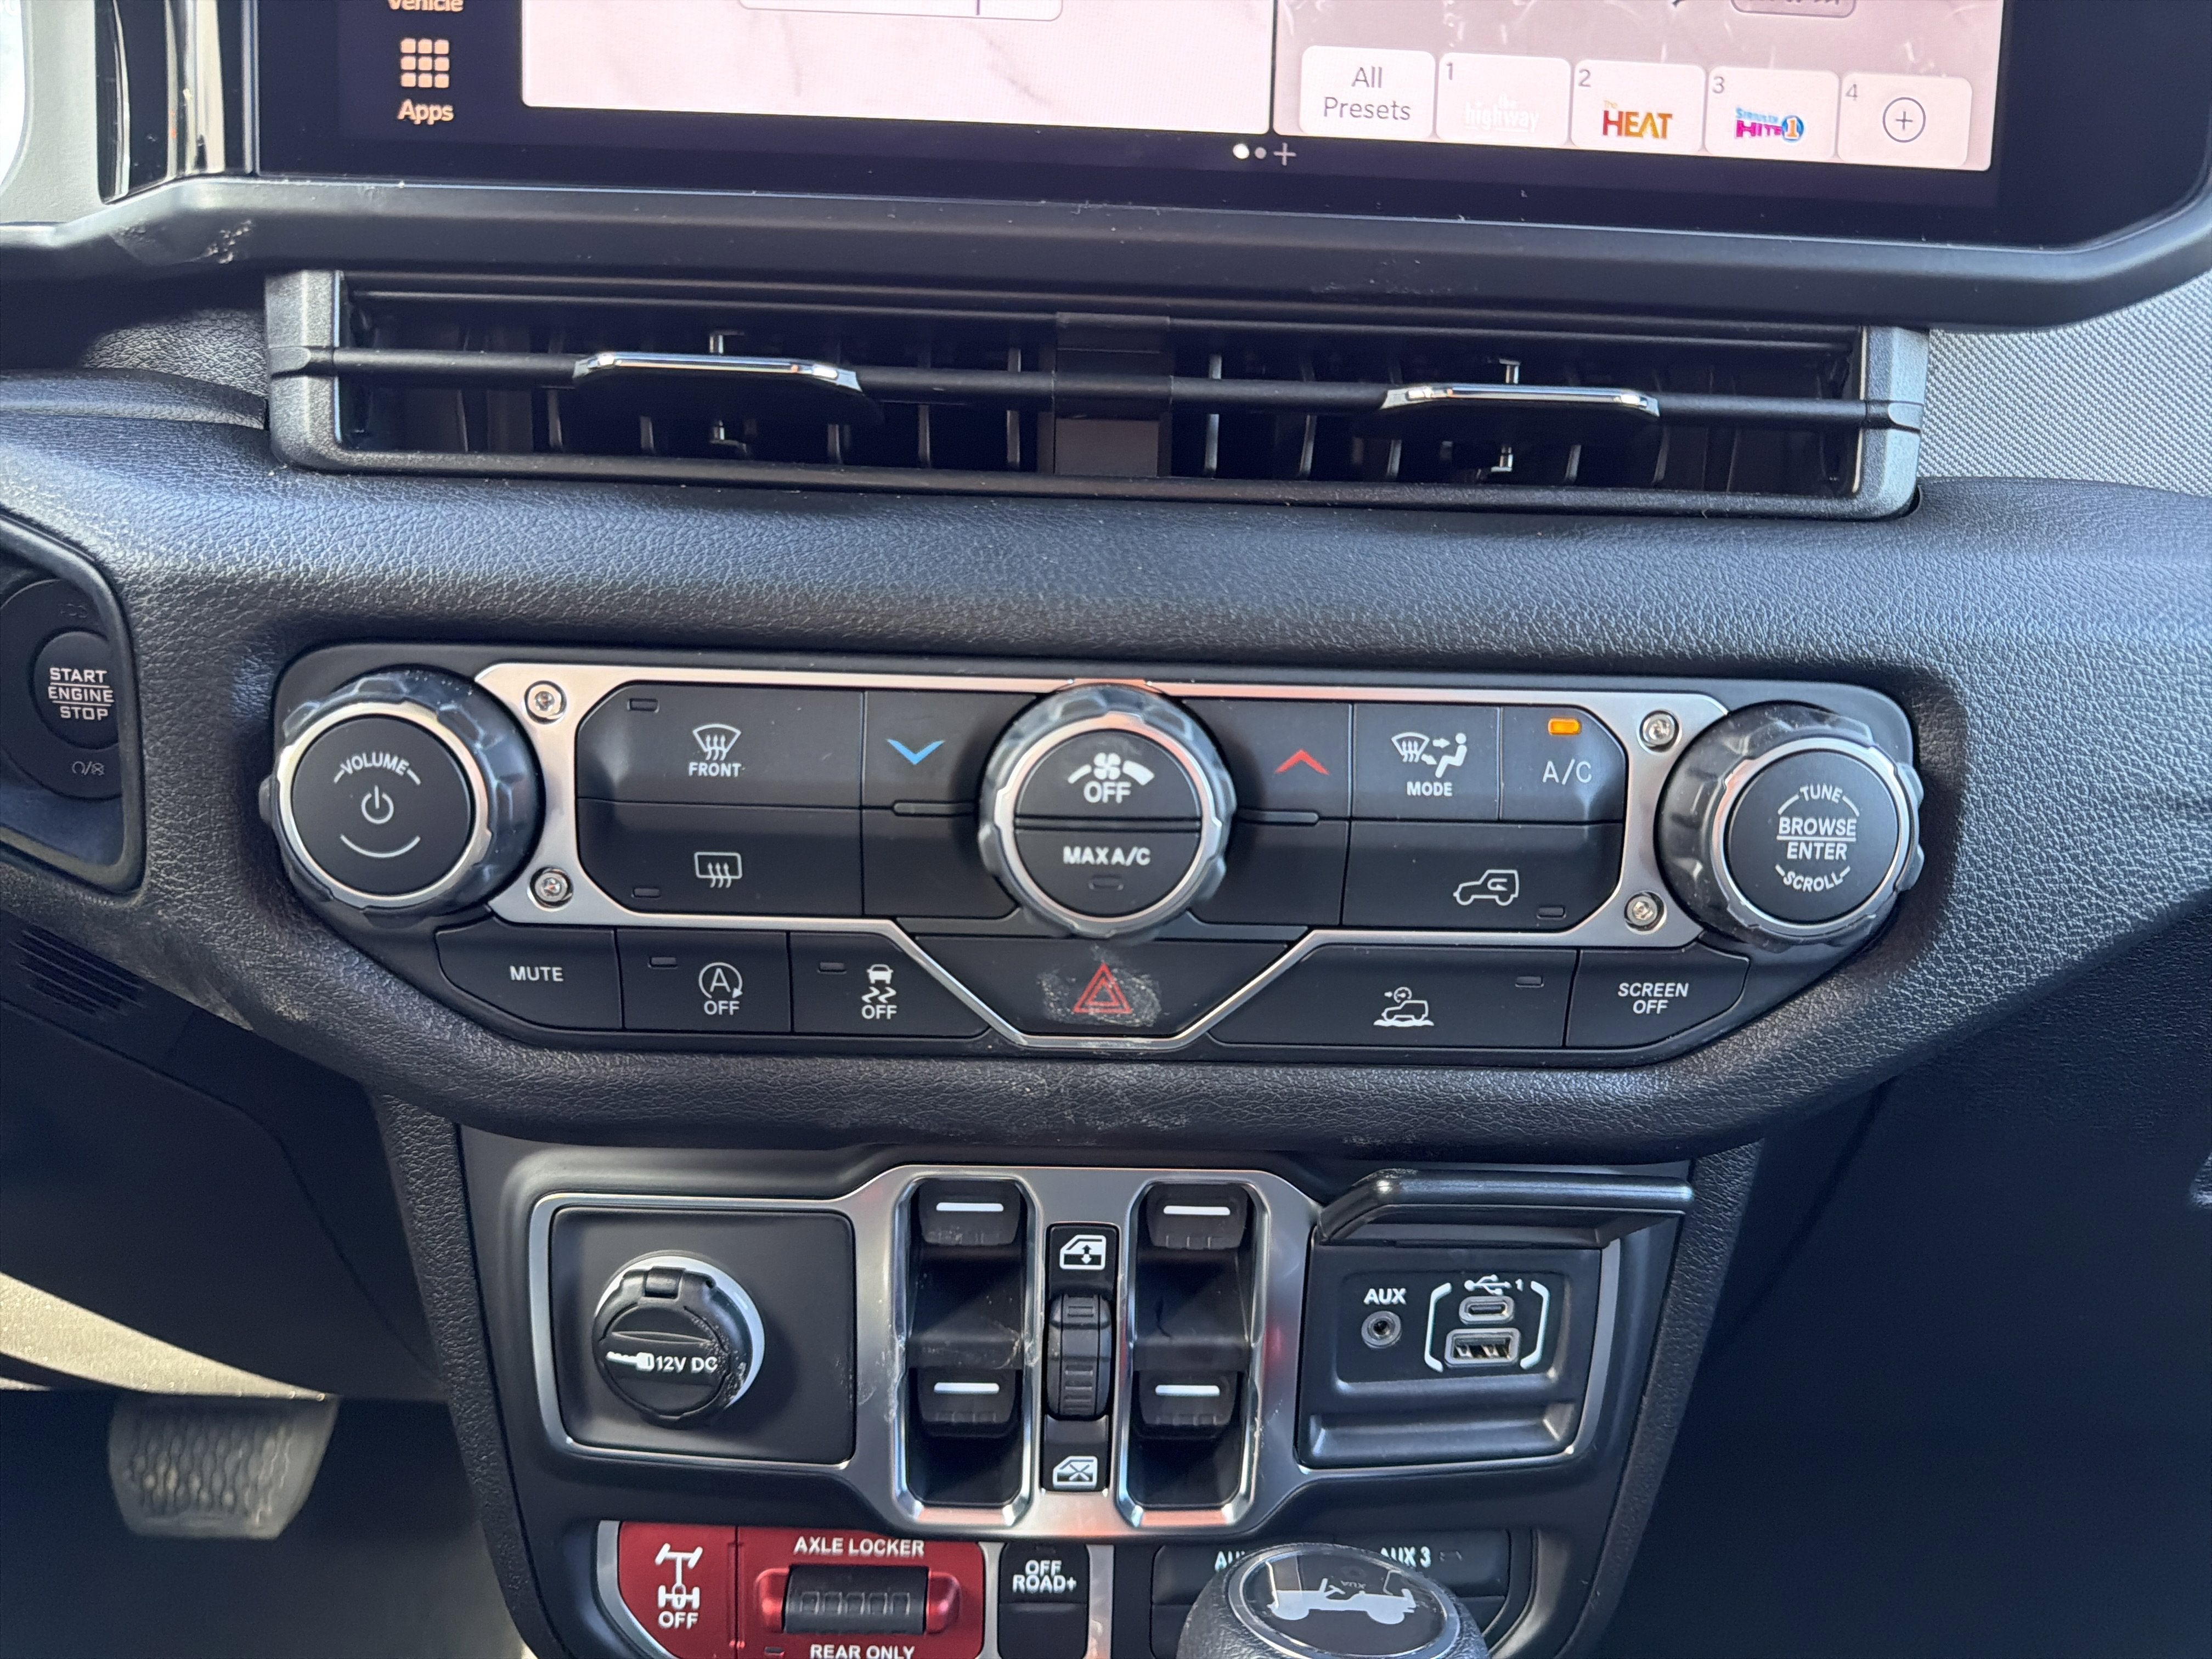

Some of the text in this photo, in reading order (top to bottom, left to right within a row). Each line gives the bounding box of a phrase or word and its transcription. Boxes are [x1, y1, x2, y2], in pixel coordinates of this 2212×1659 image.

[1351, 66, 1383, 88] All
[1446, 63, 1453, 80] 1
[1578, 69, 1591, 87] 2
[1712, 76, 1725, 94] 3
[1845, 83, 1858, 100] 4
[397, 99, 455, 125] Apps
[1323, 97, 1412, 120] Presets
[1602, 110, 1673, 139] HEAT
[49, 667, 108, 683] START
[48, 686, 115, 703] ENGINE
[60, 706, 109, 721] STOP
[340, 752, 410, 776] VOLUME
[689, 761, 742, 777] FRONT
[1542, 759, 1592, 785] A/C
[1084, 781, 1132, 803] OFF
[1406, 781, 1453, 797] MODE
[1799, 783, 1844, 804] TUNE
[1778, 816, 1857, 837] BROWSE
[1063, 845, 1152, 866] MAX A/C
[1786, 841, 1848, 861] ENTER
[1782, 870, 1844, 892] SCROLL
[510, 965, 565, 982] MUTE
[1617, 981, 1690, 998] SCREEN
[703, 1000, 741, 1015] OFF
[861, 1004, 898, 1020] OFF
[1632, 999, 1670, 1014] OFF
[1363, 1288, 1406, 1305] AUX
[656, 1356, 718, 1372] 12V DC
[793, 1536, 925, 1559] AXLE LOCKER
[1215, 1550, 1245, 1572] AU
[1420, 1546, 1432, 1568] 3
[1025, 1560, 1062, 1578] OFF
[658, 1611, 699, 1629] OFF
[810, 1644, 915, 1659] REAR ONLY
